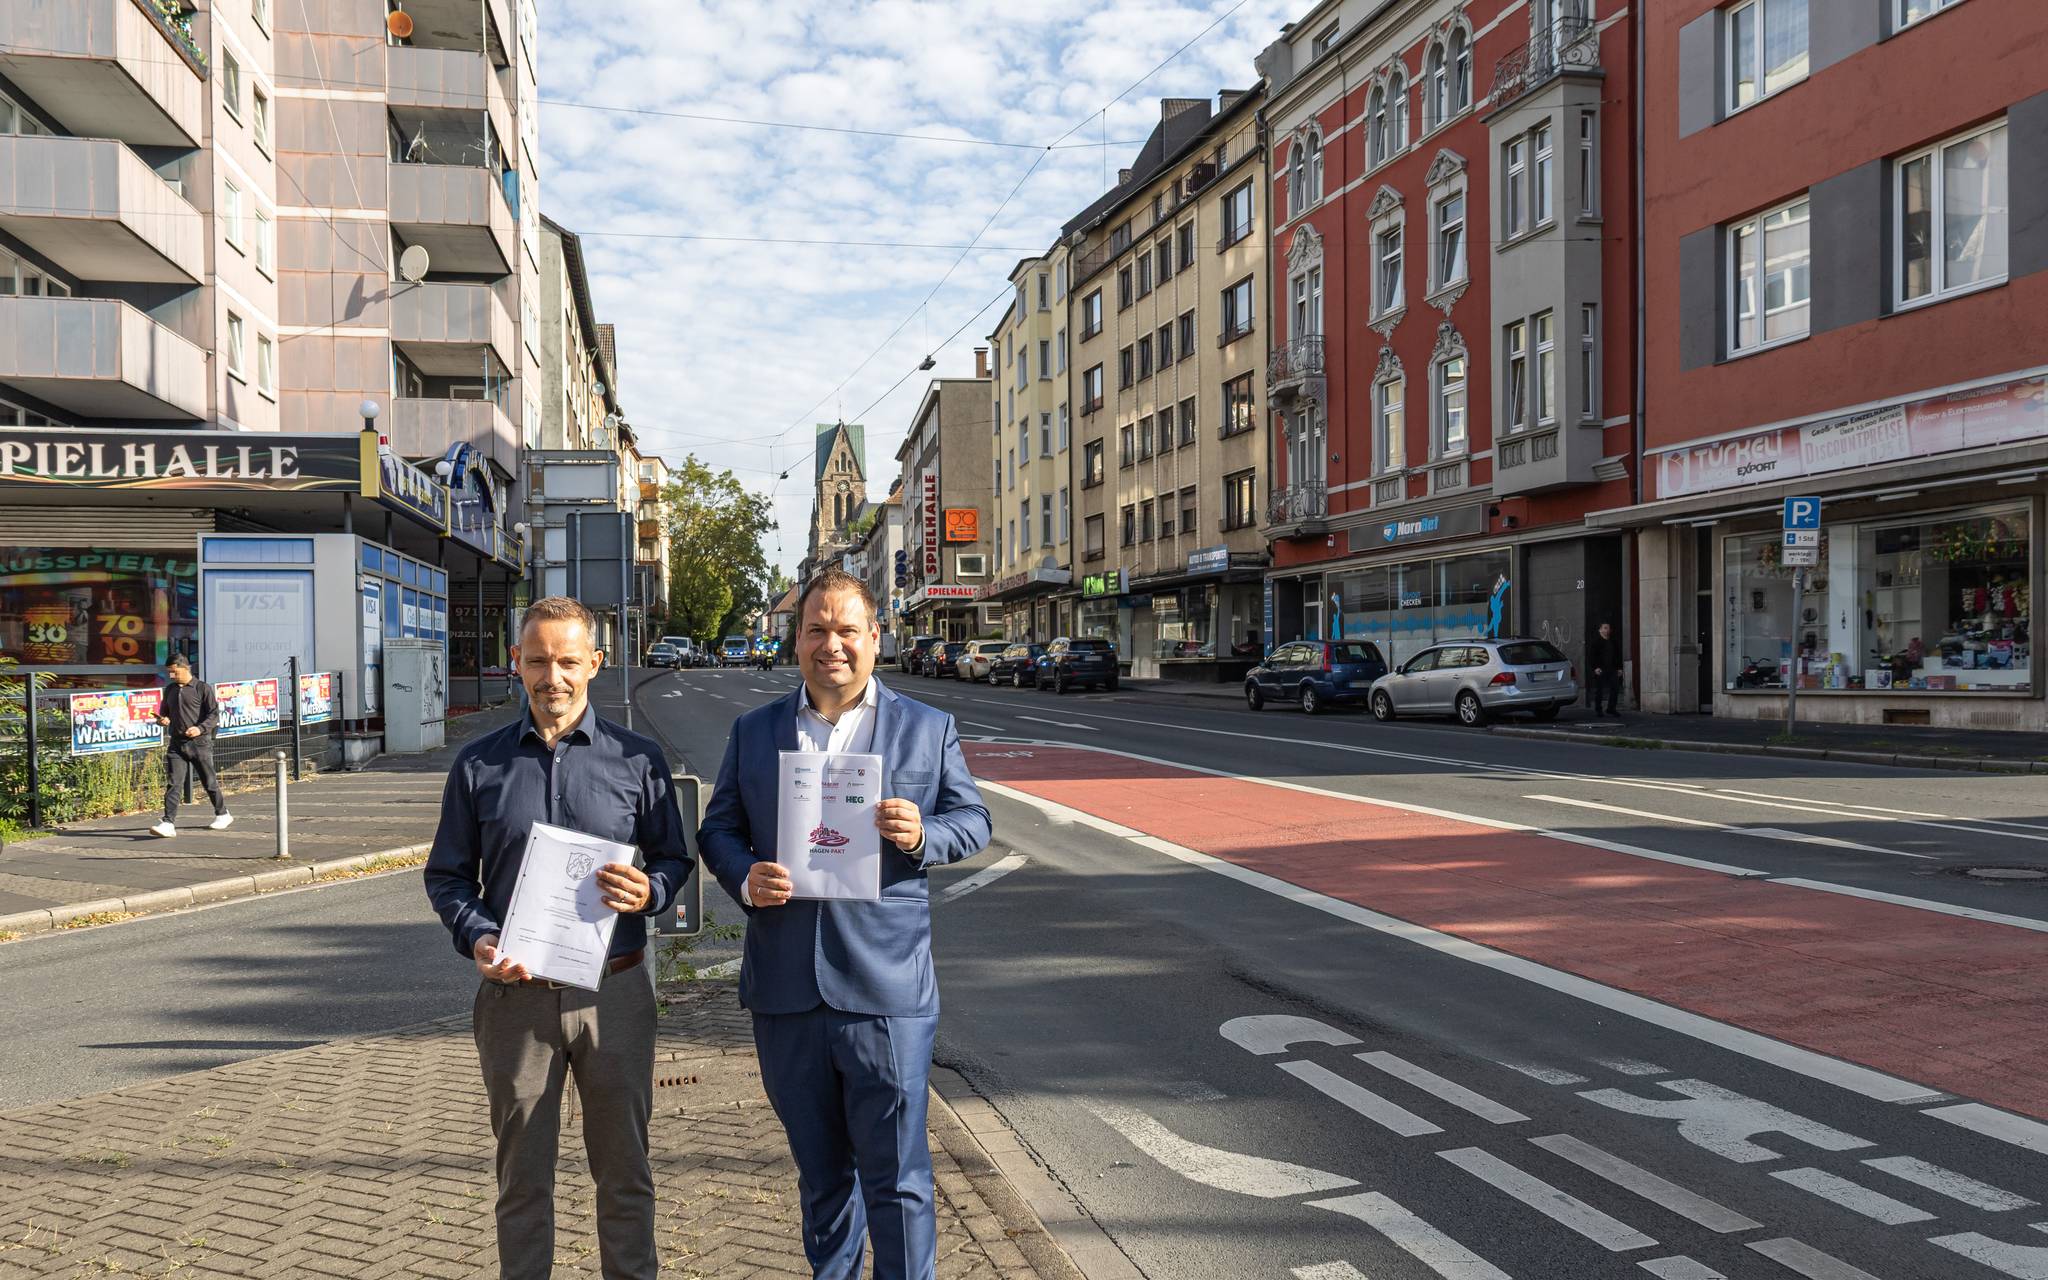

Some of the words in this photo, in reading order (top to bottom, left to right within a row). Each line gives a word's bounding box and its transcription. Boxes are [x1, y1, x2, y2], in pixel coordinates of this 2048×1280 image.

[1737, 460, 1777, 477] EXPORT
[1792, 501, 1812, 525] P
[924, 474, 938, 575] SPIELHALLE
[1576, 579, 1585, 589] 20
[233, 594, 286, 610] VISA
[28, 623, 68, 643] 30
[96, 614, 145, 635] 70
[76, 723, 161, 745] WATERLAND
[846, 795, 864, 804] HEG
